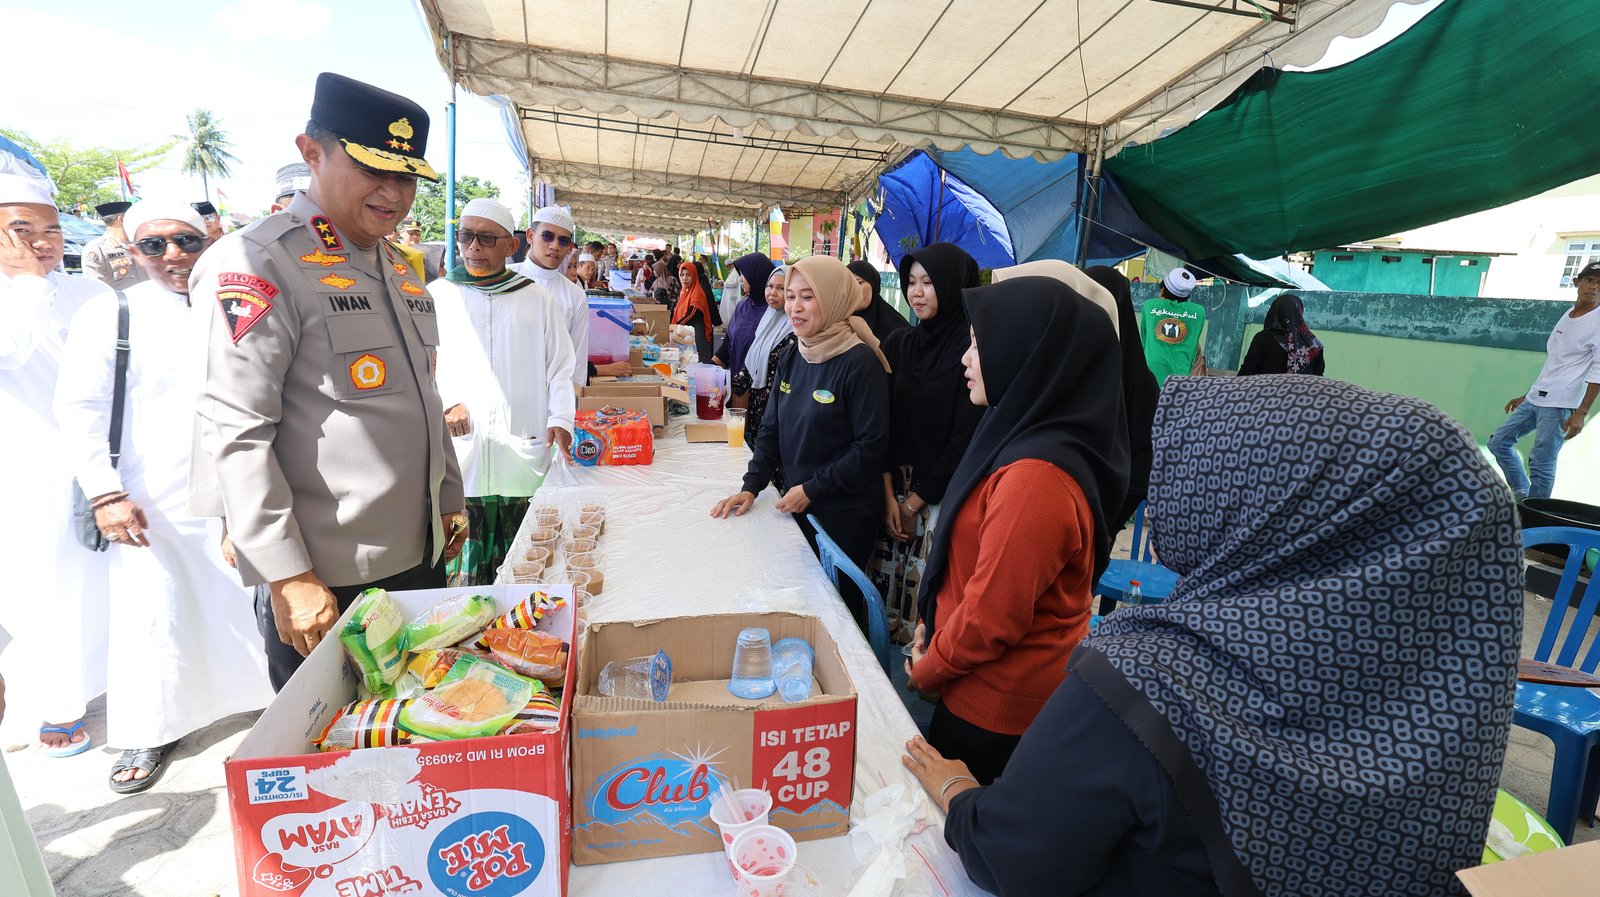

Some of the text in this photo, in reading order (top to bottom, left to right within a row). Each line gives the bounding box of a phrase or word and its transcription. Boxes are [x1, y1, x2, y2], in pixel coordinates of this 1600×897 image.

[220, 274, 275, 296] PELOPOR
[329, 296, 371, 312] IWAN
[581, 445, 596, 455] Cleo
[760, 721, 851, 747] ISI TETAP
[466, 750, 487, 762] MD
[490, 748, 503, 759] RI
[507, 744, 545, 758] BPOM
[772, 746, 831, 781] 48
[261, 769, 290, 778] CUPS
[255, 776, 297, 795] 24
[606, 763, 710, 812] Club
[778, 780, 829, 802] CUP
[253, 792, 303, 802] ISI/CONTENT
[392, 808, 446, 827] RASA LEBIH
[279, 814, 362, 850] AYAM
[311, 841, 340, 853] RASA
[439, 825, 512, 876] MIE
[467, 842, 532, 891] POP
